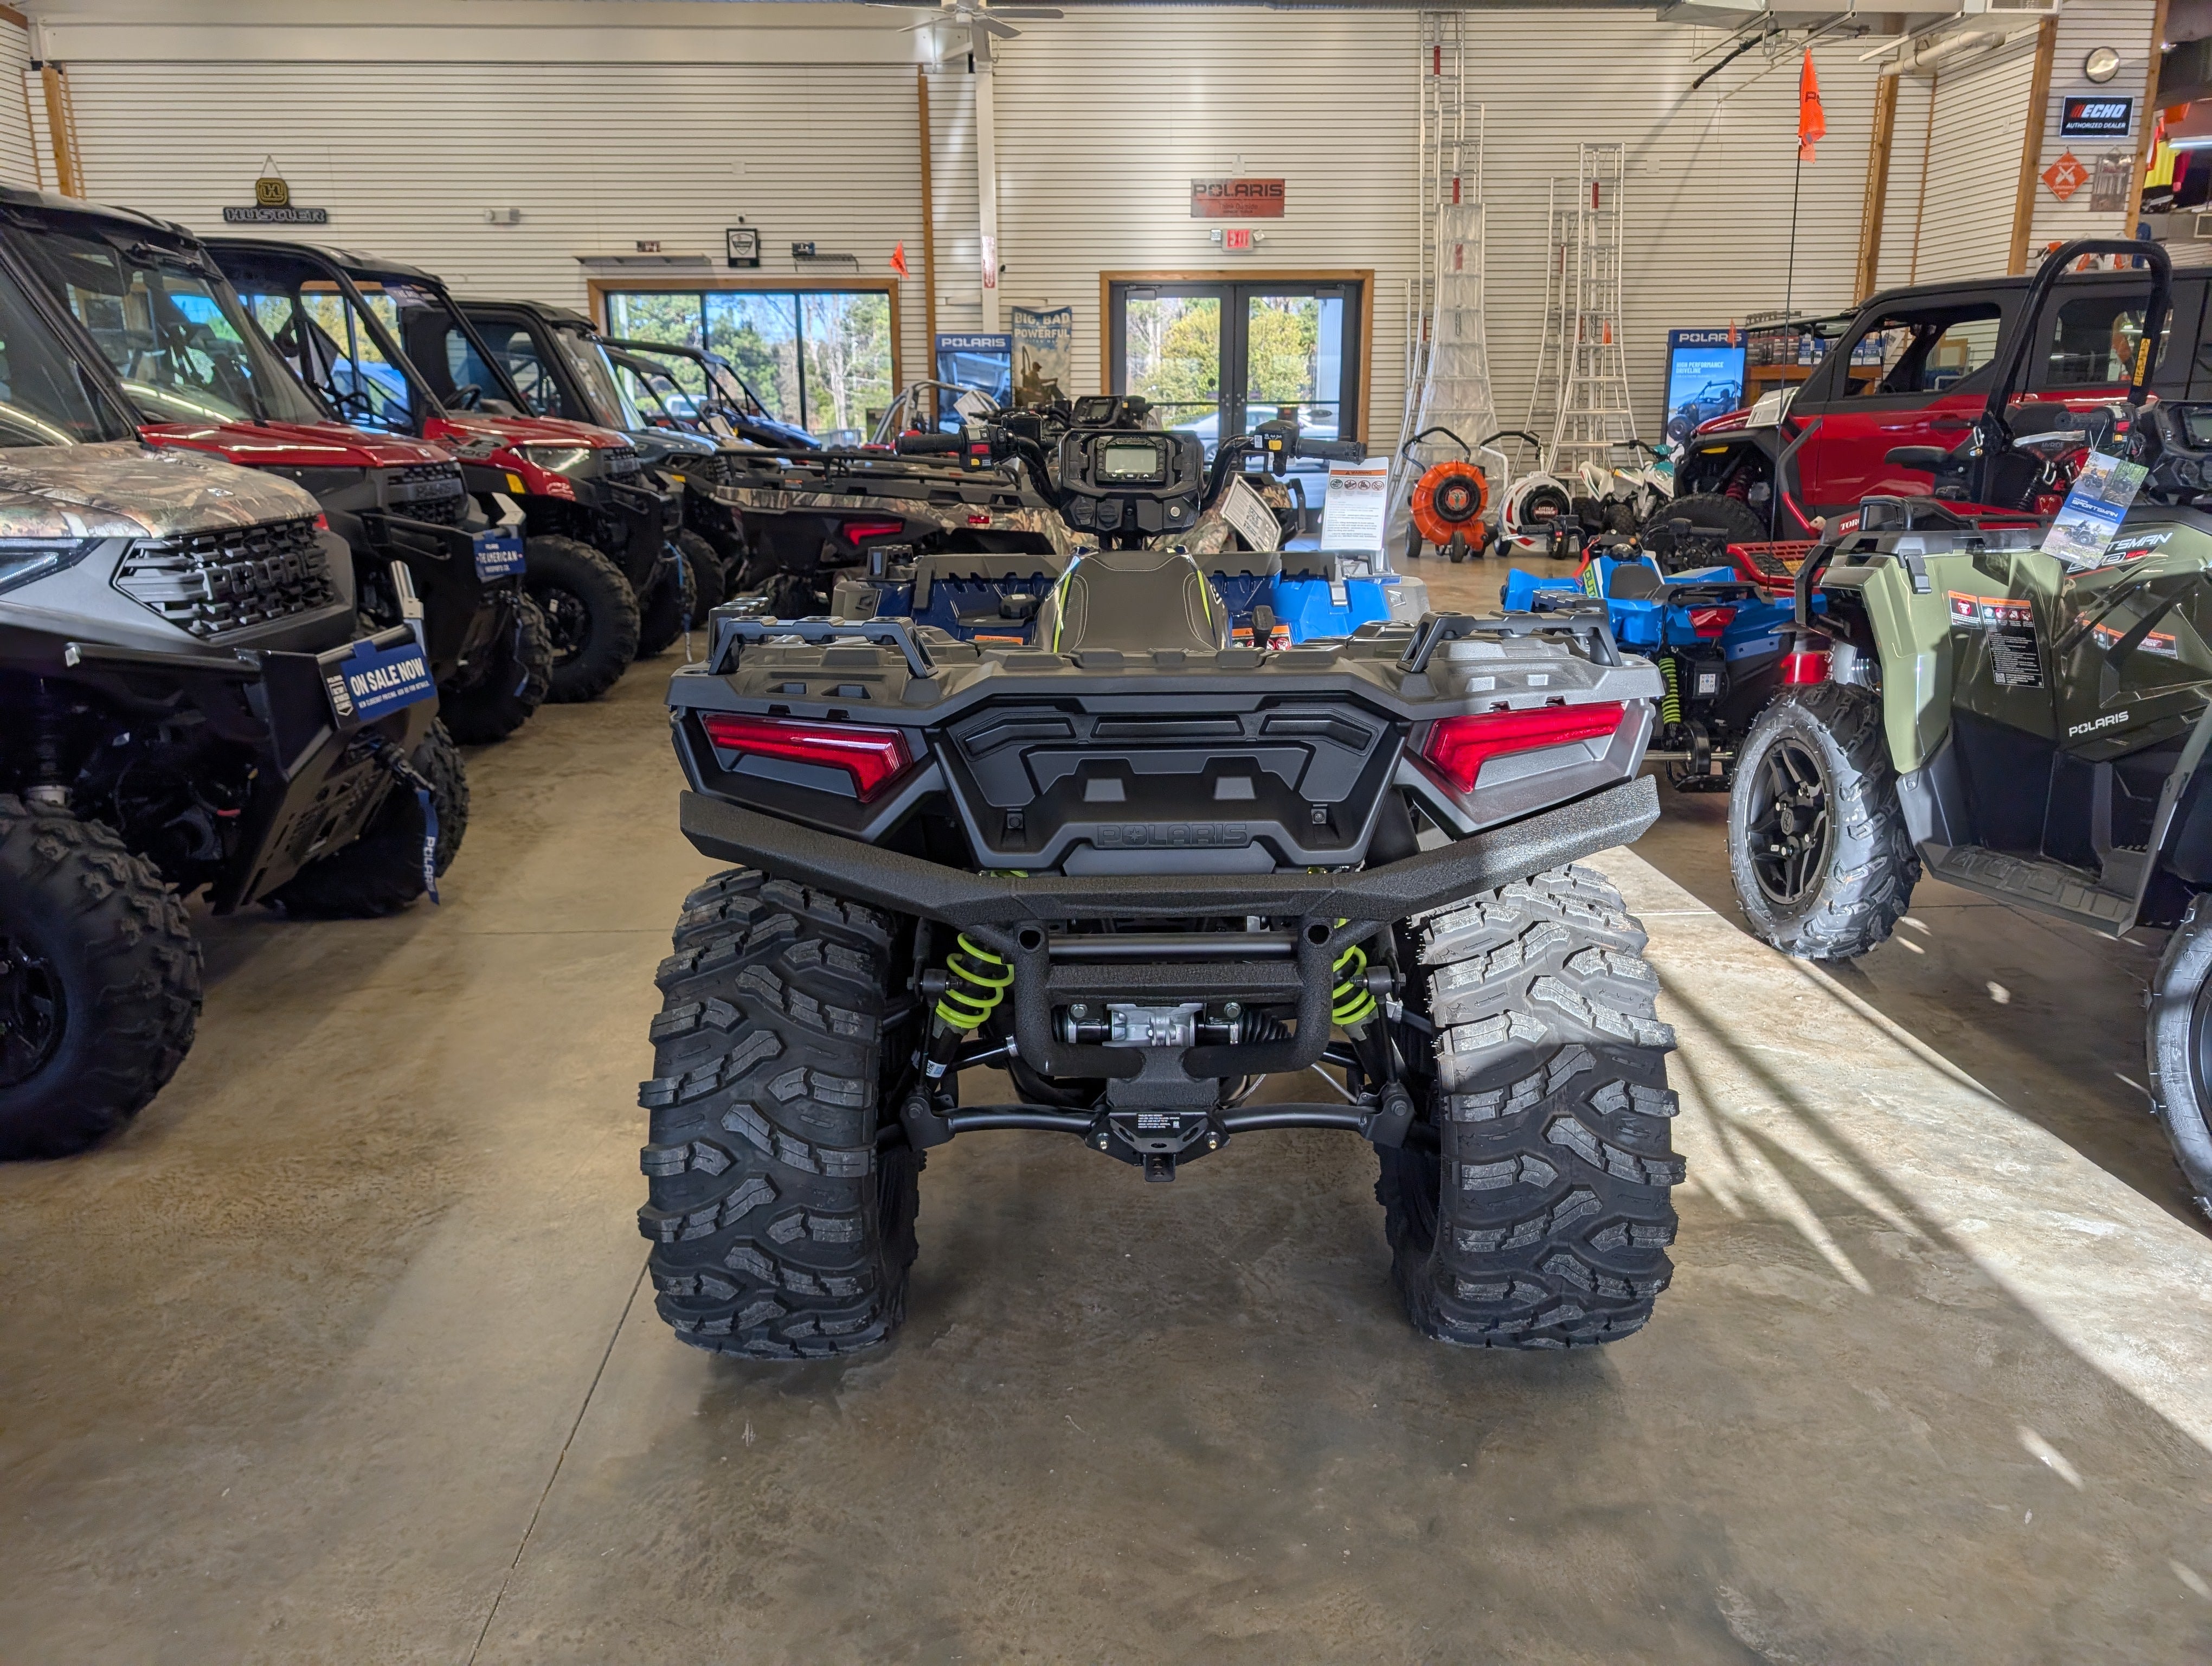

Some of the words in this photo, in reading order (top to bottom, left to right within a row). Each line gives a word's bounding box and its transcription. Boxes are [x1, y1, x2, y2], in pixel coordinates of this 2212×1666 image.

[2081, 104, 2127, 118] ECHO
[1193, 184, 1283, 197] POLARIS
[225, 208, 325, 222] HUSTLER
[1227, 229, 1250, 247] EXIT
[1014, 312, 1039, 325] BIG,
[1043, 312, 1070, 325] BAD
[1014, 328, 1070, 338] POWERFUL
[1679, 333, 1742, 343] POLARS
[941, 337, 1006, 348] POLARIS
[2072, 499, 2119, 518] SPORTSMAN
[2107, 532, 2174, 552] TSMAN
[196, 549, 332, 600] POLARIS
[1584, 569, 1597, 597] OUT
[350, 674, 370, 697] ON
[366, 665, 401, 691] SALE
[396, 657, 426, 682] NOW
[2068, 710, 2129, 737] POLARIS
[1097, 824, 1247, 847] POLARIS
